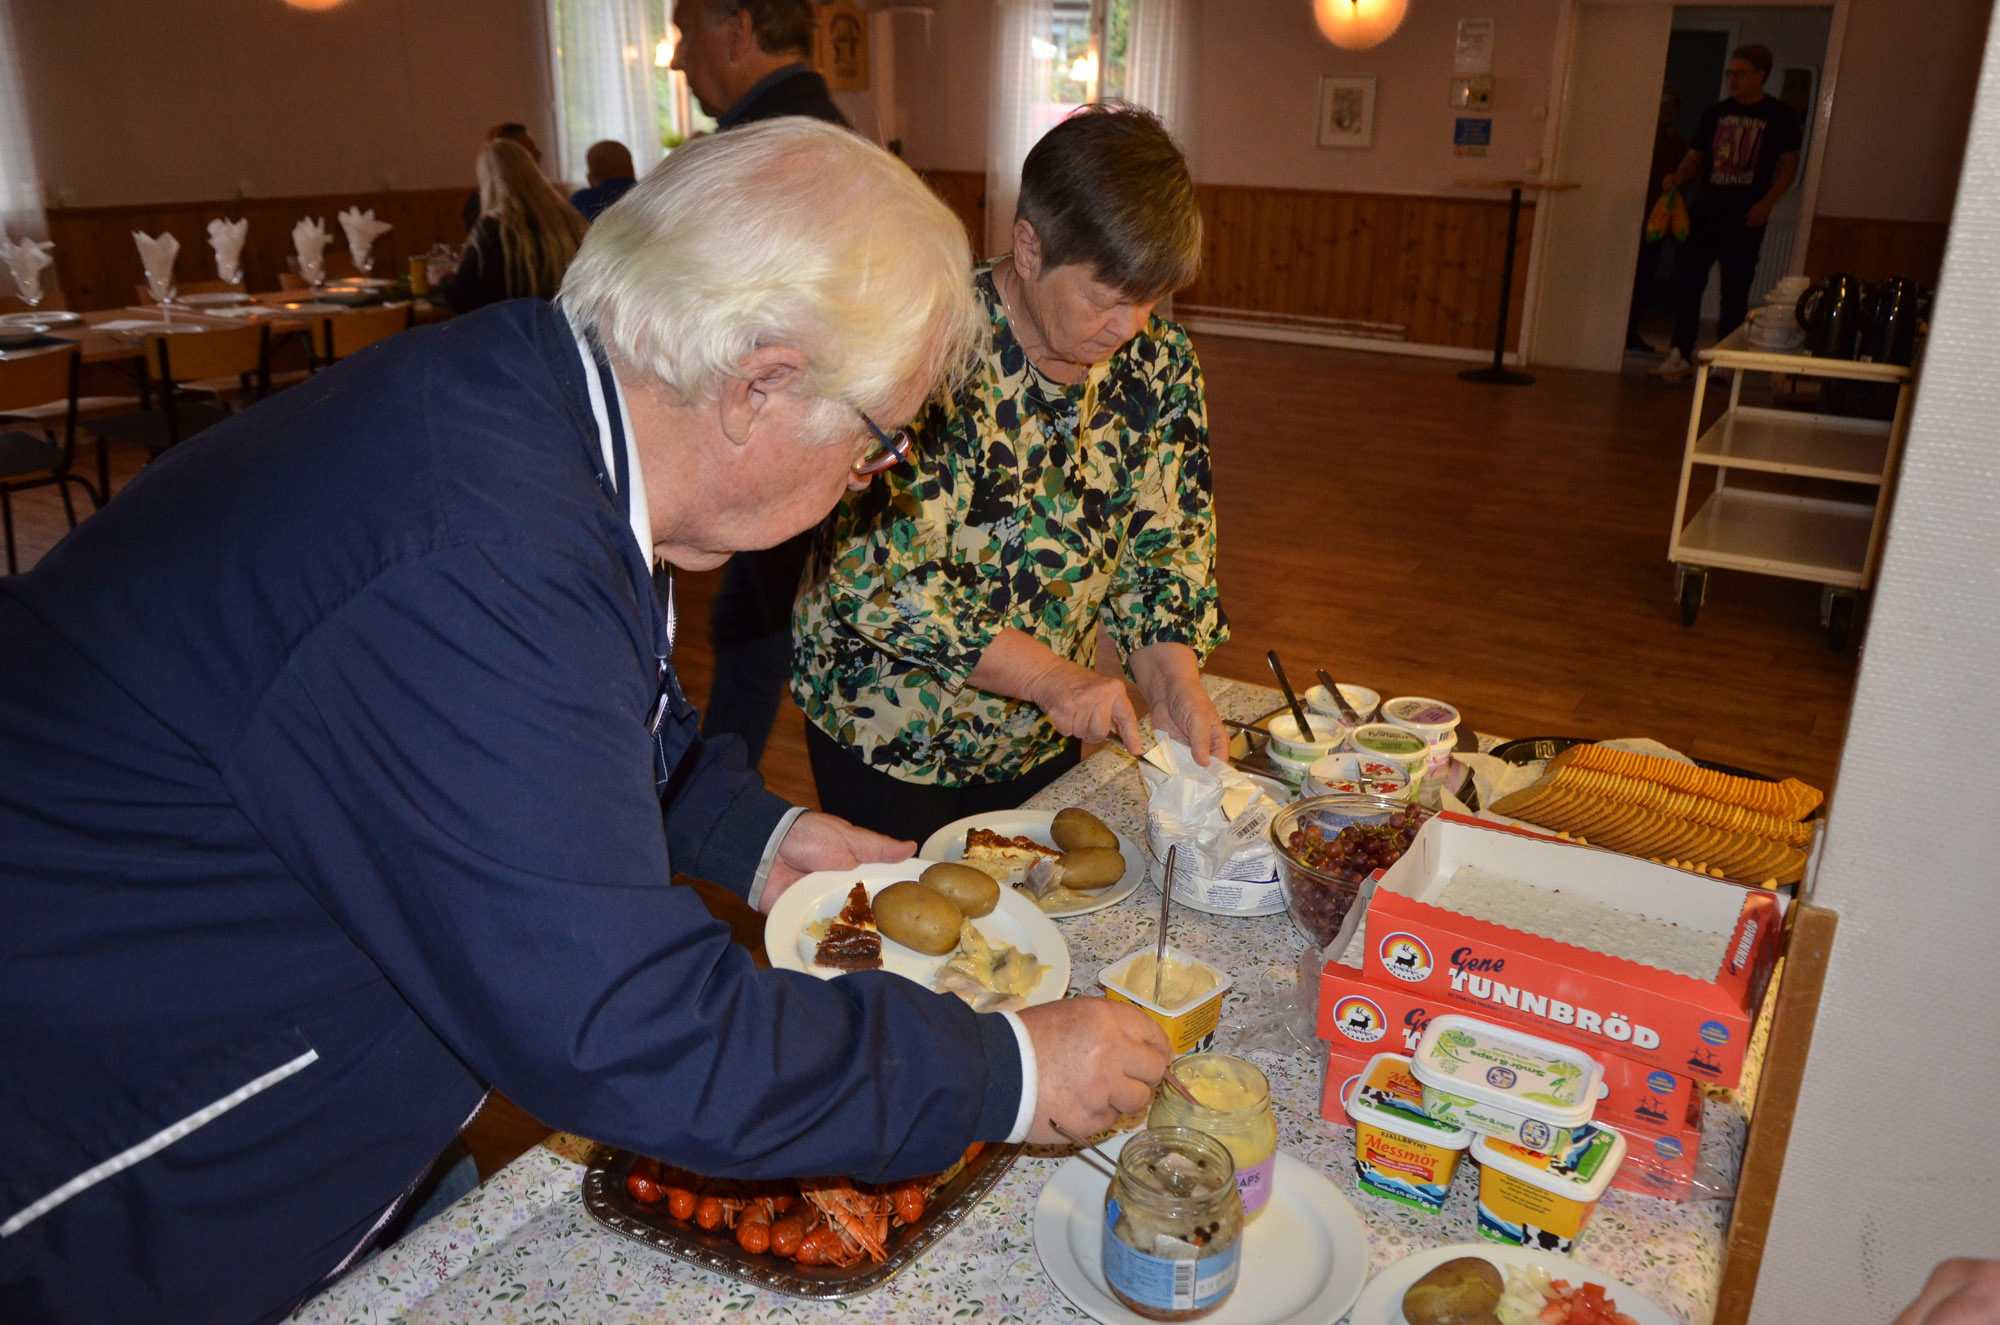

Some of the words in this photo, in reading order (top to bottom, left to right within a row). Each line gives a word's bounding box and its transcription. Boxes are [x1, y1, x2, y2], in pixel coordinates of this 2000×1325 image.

[1451, 947, 1505, 979] Gene
[1448, 968, 1661, 1050] TUNNBRÖD
[1470, 1050, 1498, 1062] raps
[1510, 1062, 1545, 1077] Smör
[1465, 1110, 1488, 1122] Smör
[1496, 1121, 1516, 1131] raps
[1364, 1133, 1440, 1168] Messmör
[1236, 1172, 1260, 1188] APS
